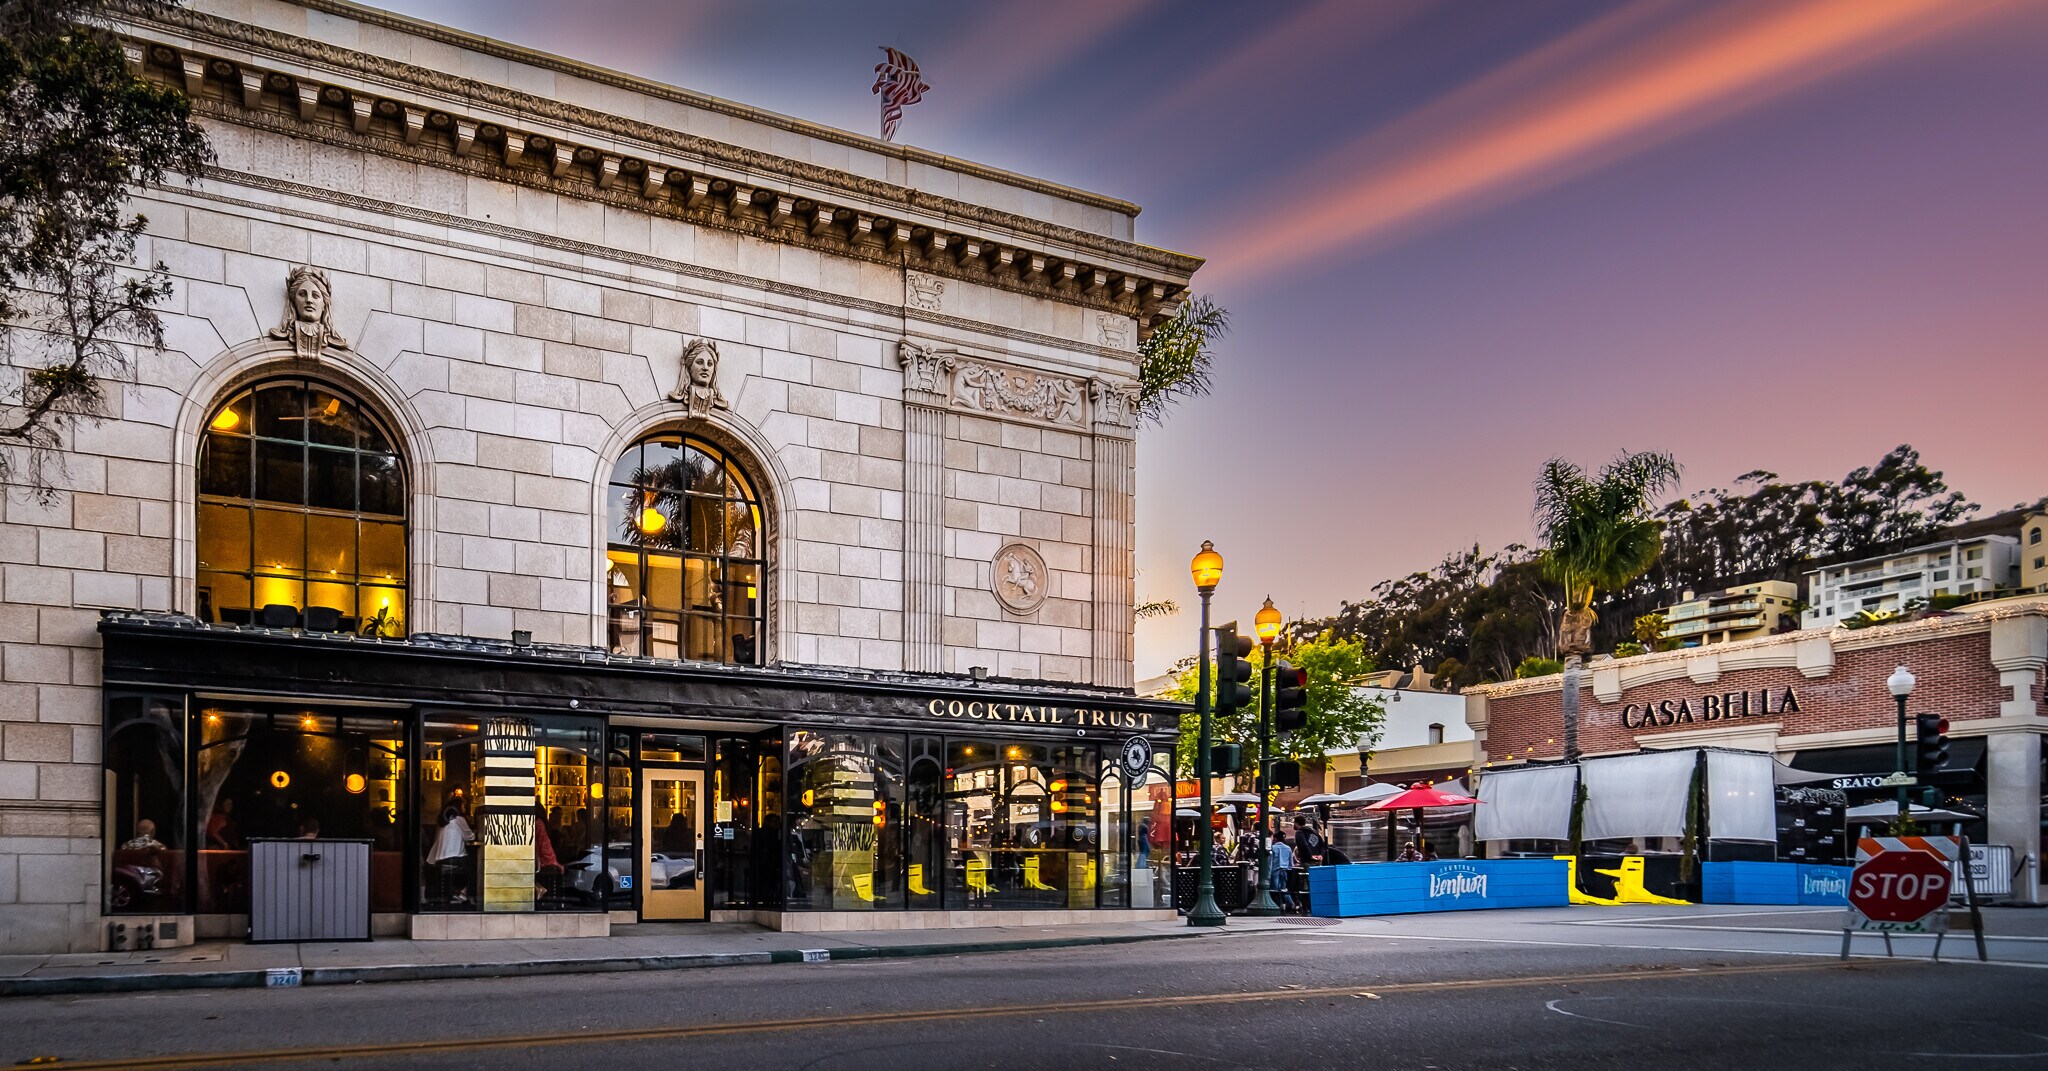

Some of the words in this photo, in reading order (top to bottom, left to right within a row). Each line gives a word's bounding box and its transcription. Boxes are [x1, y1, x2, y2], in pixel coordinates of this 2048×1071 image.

[929, 699, 1063, 723] COCKTAIL
[1074, 708, 1153, 729] TRUST
[1622, 698, 1694, 729] CASA
[1703, 685, 1800, 721] BELLA
[1832, 776, 1883, 789] SEAFO
[1855, 872, 1945, 901] STOP
